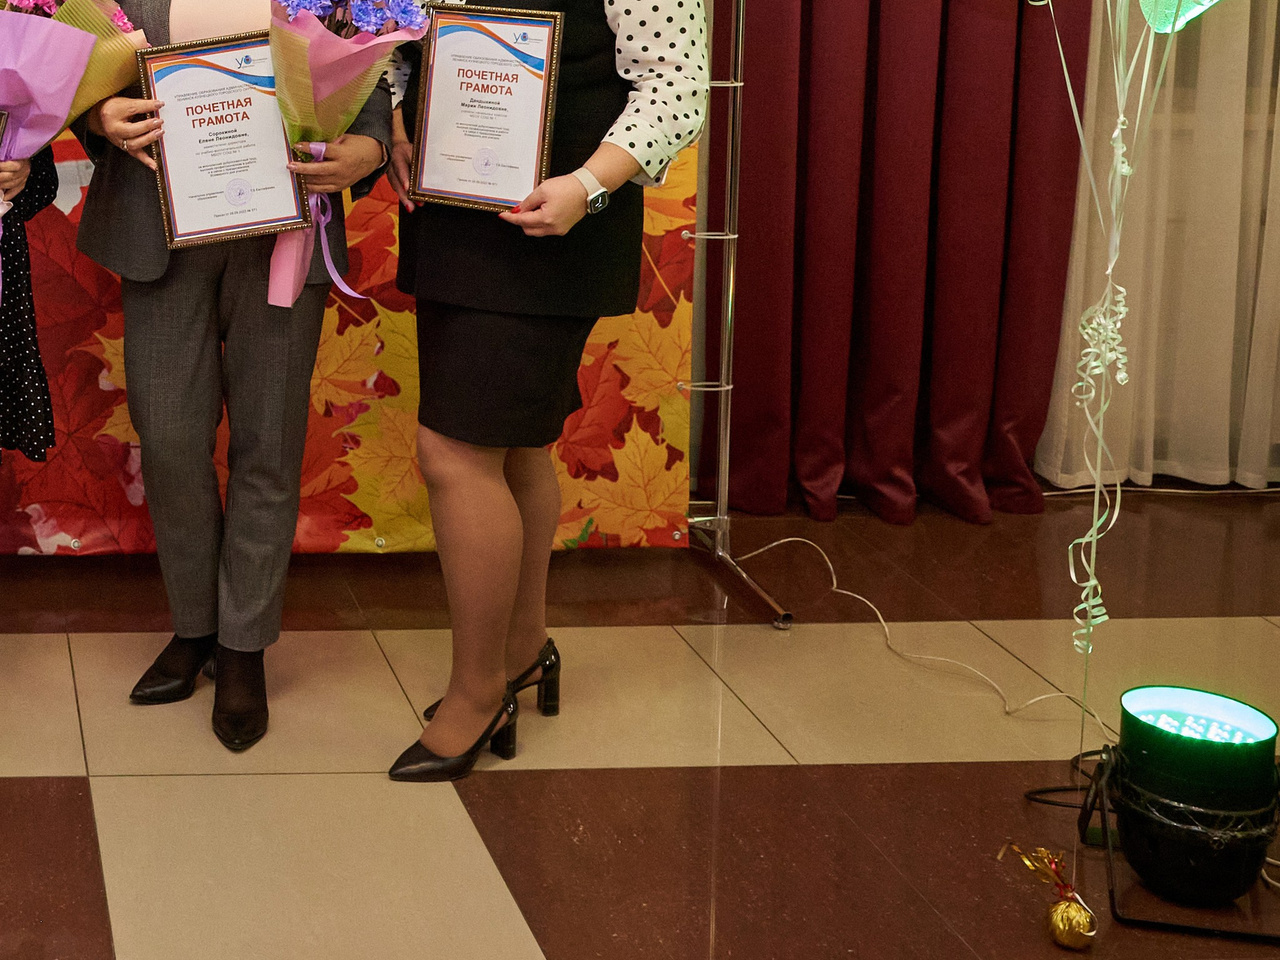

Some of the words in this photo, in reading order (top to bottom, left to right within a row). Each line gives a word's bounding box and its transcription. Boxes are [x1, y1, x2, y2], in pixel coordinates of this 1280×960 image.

[457, 68, 518, 83] ПОЧЕТНАЯ
[460, 81, 513, 96] ГРАМОТА
[186, 97, 252, 116] ПОЧЕТНАЯ
[192, 111, 249, 128] ГРАМОТА
